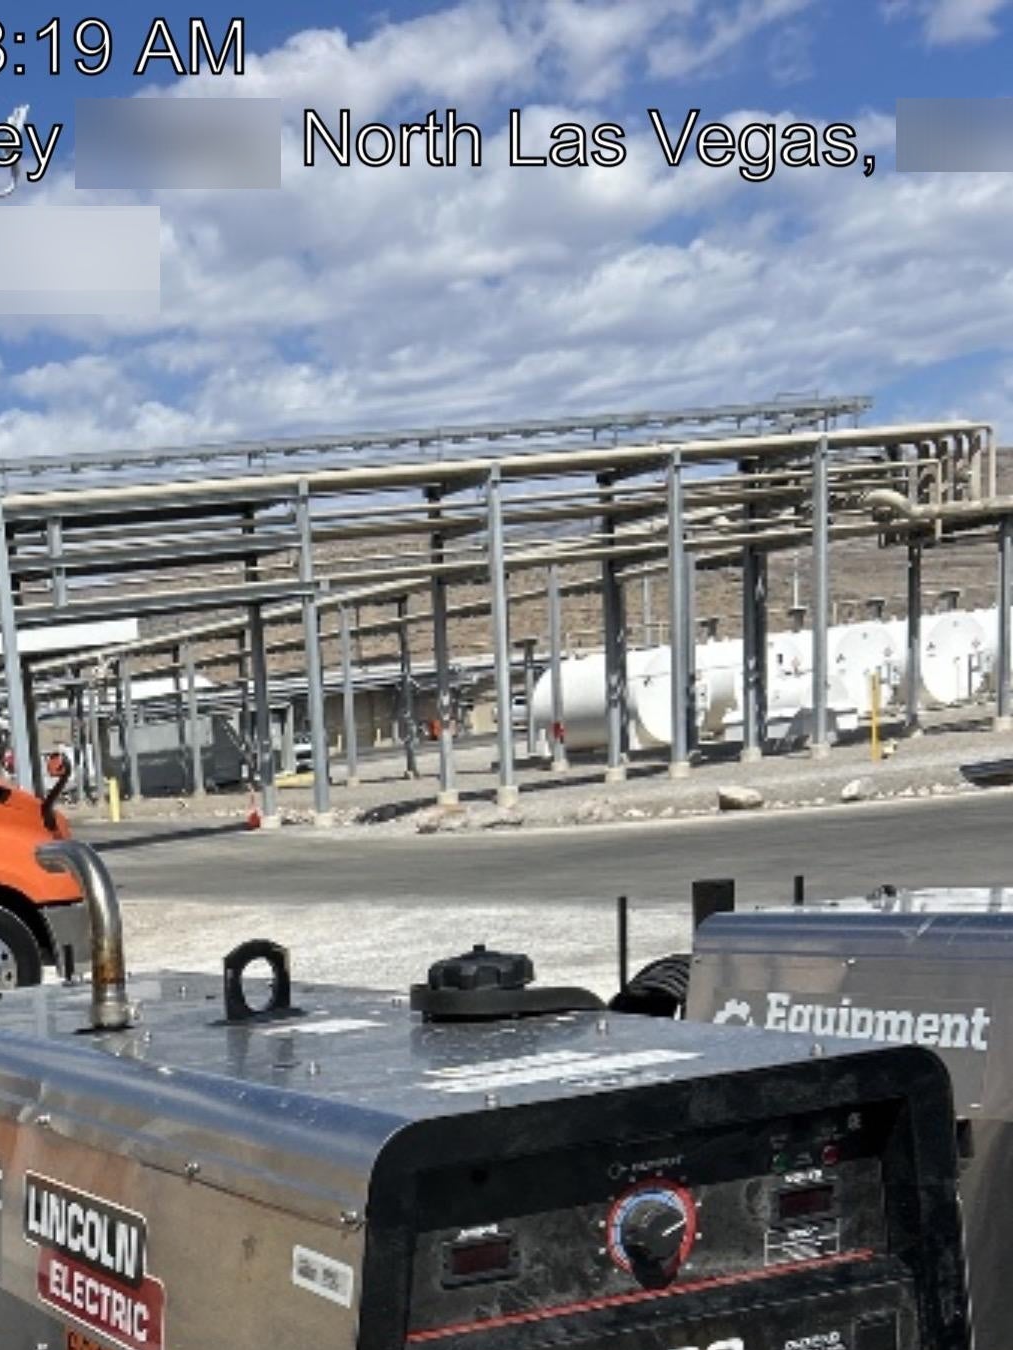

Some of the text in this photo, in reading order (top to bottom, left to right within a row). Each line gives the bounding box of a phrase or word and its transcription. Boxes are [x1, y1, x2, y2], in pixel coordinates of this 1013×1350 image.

[764, 992, 990, 1050] Equipment
[27, 1184, 139, 1280] LINCOLN
[49, 1259, 149, 1343] ELECTRIC
